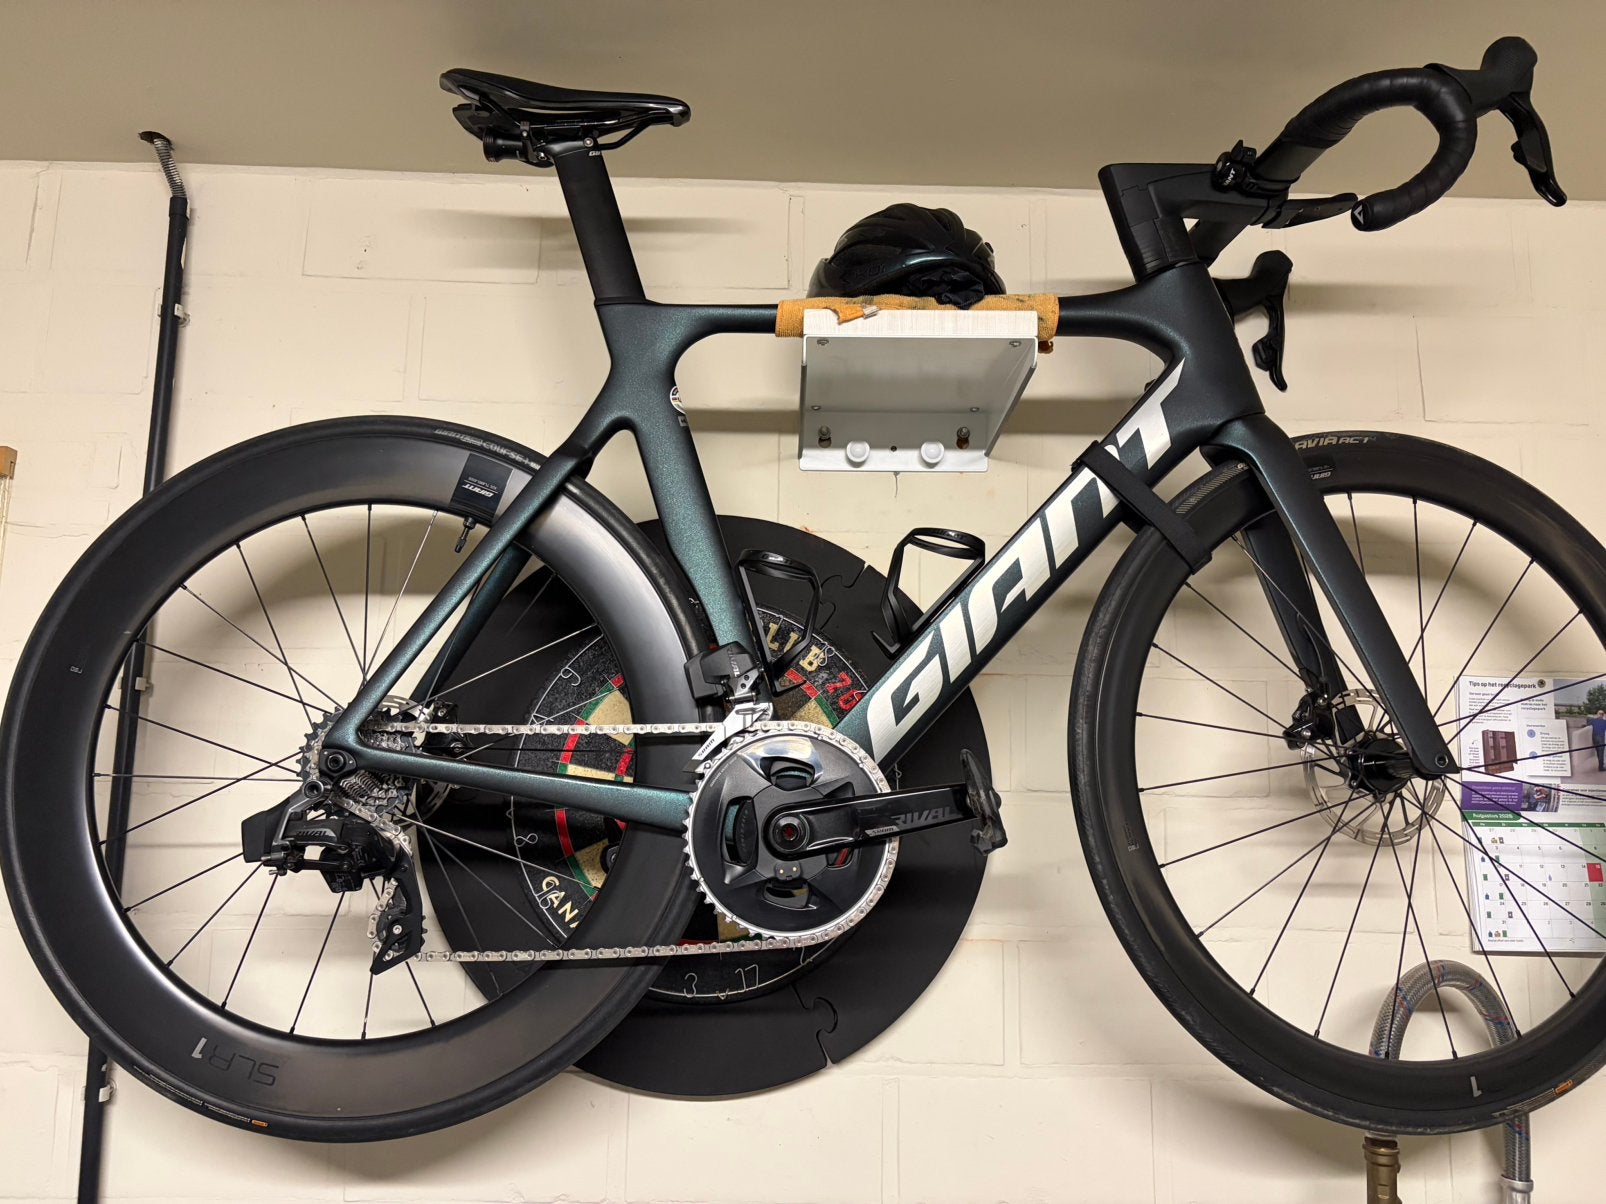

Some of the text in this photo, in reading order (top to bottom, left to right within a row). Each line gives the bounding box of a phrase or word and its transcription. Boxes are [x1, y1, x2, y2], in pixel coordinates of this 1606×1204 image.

[1294, 436, 1338, 451] AVIA
[867, 357, 1185, 764] GIANT
[890, 806, 964, 827] RIVAL
